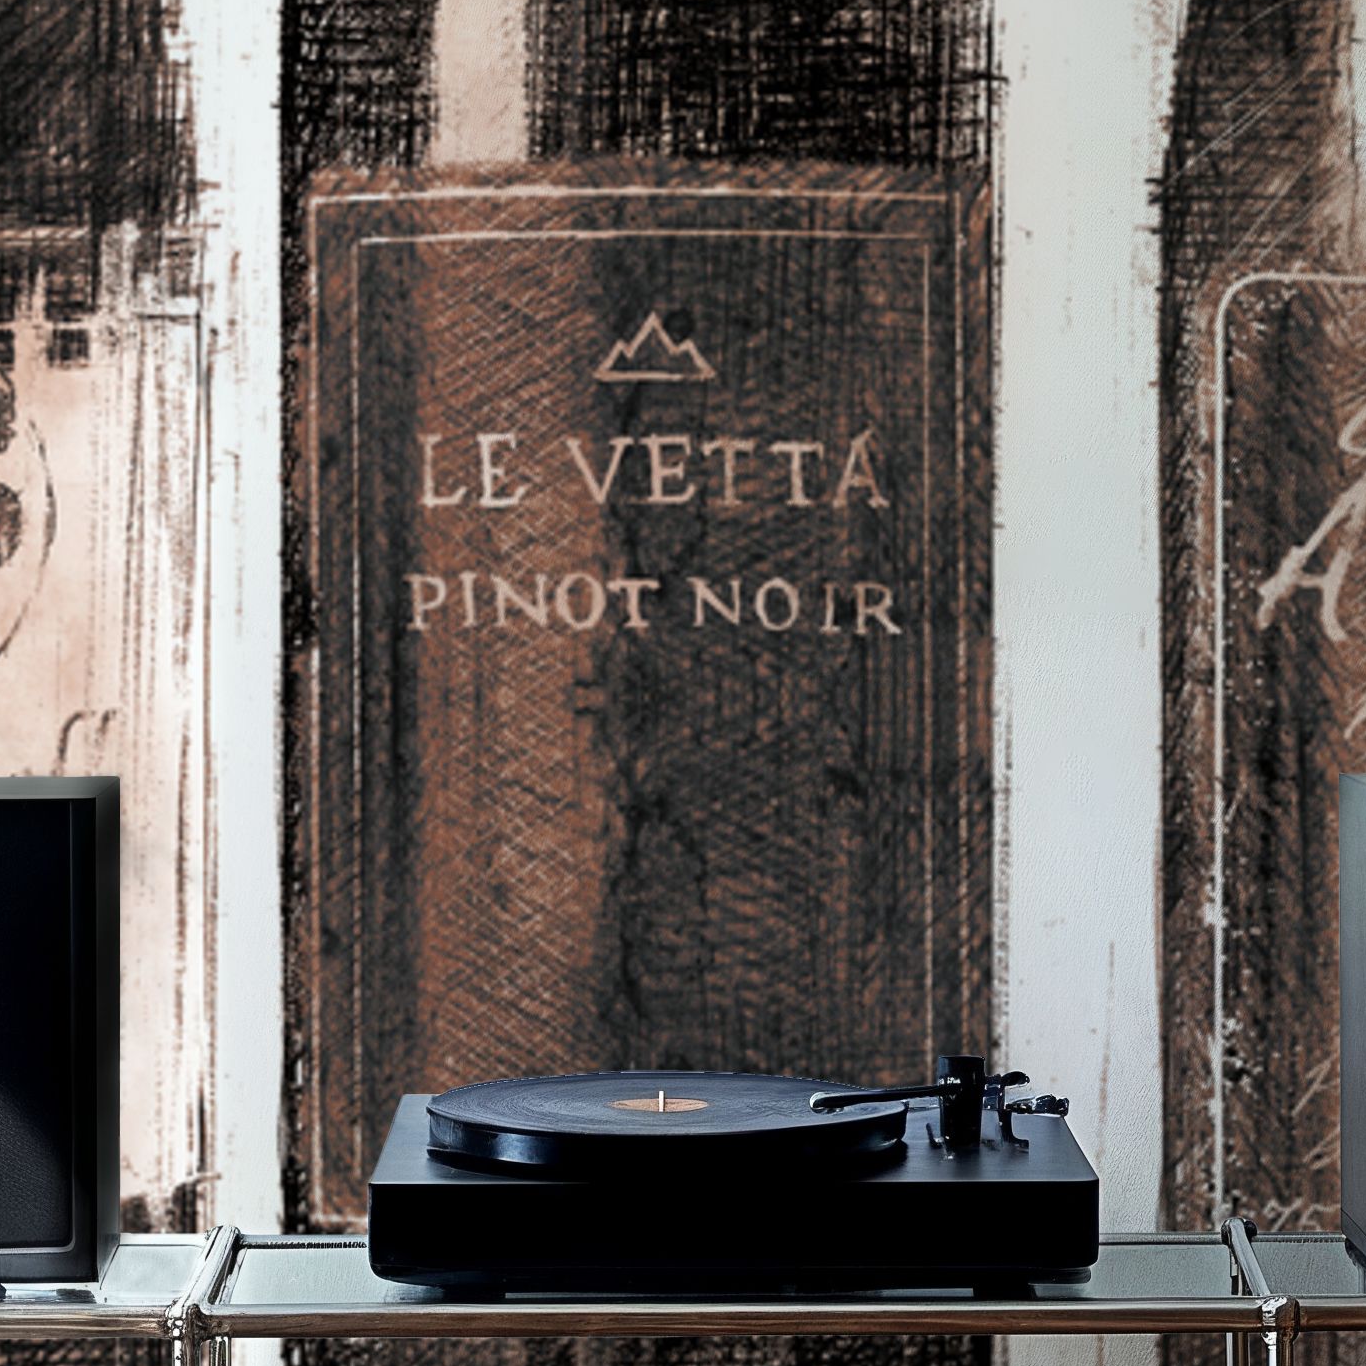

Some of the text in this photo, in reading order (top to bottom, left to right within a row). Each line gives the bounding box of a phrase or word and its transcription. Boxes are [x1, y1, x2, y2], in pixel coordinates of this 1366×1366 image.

[417, 434, 528, 508] LE
[403, 573, 903, 635] PINOT NOIR
